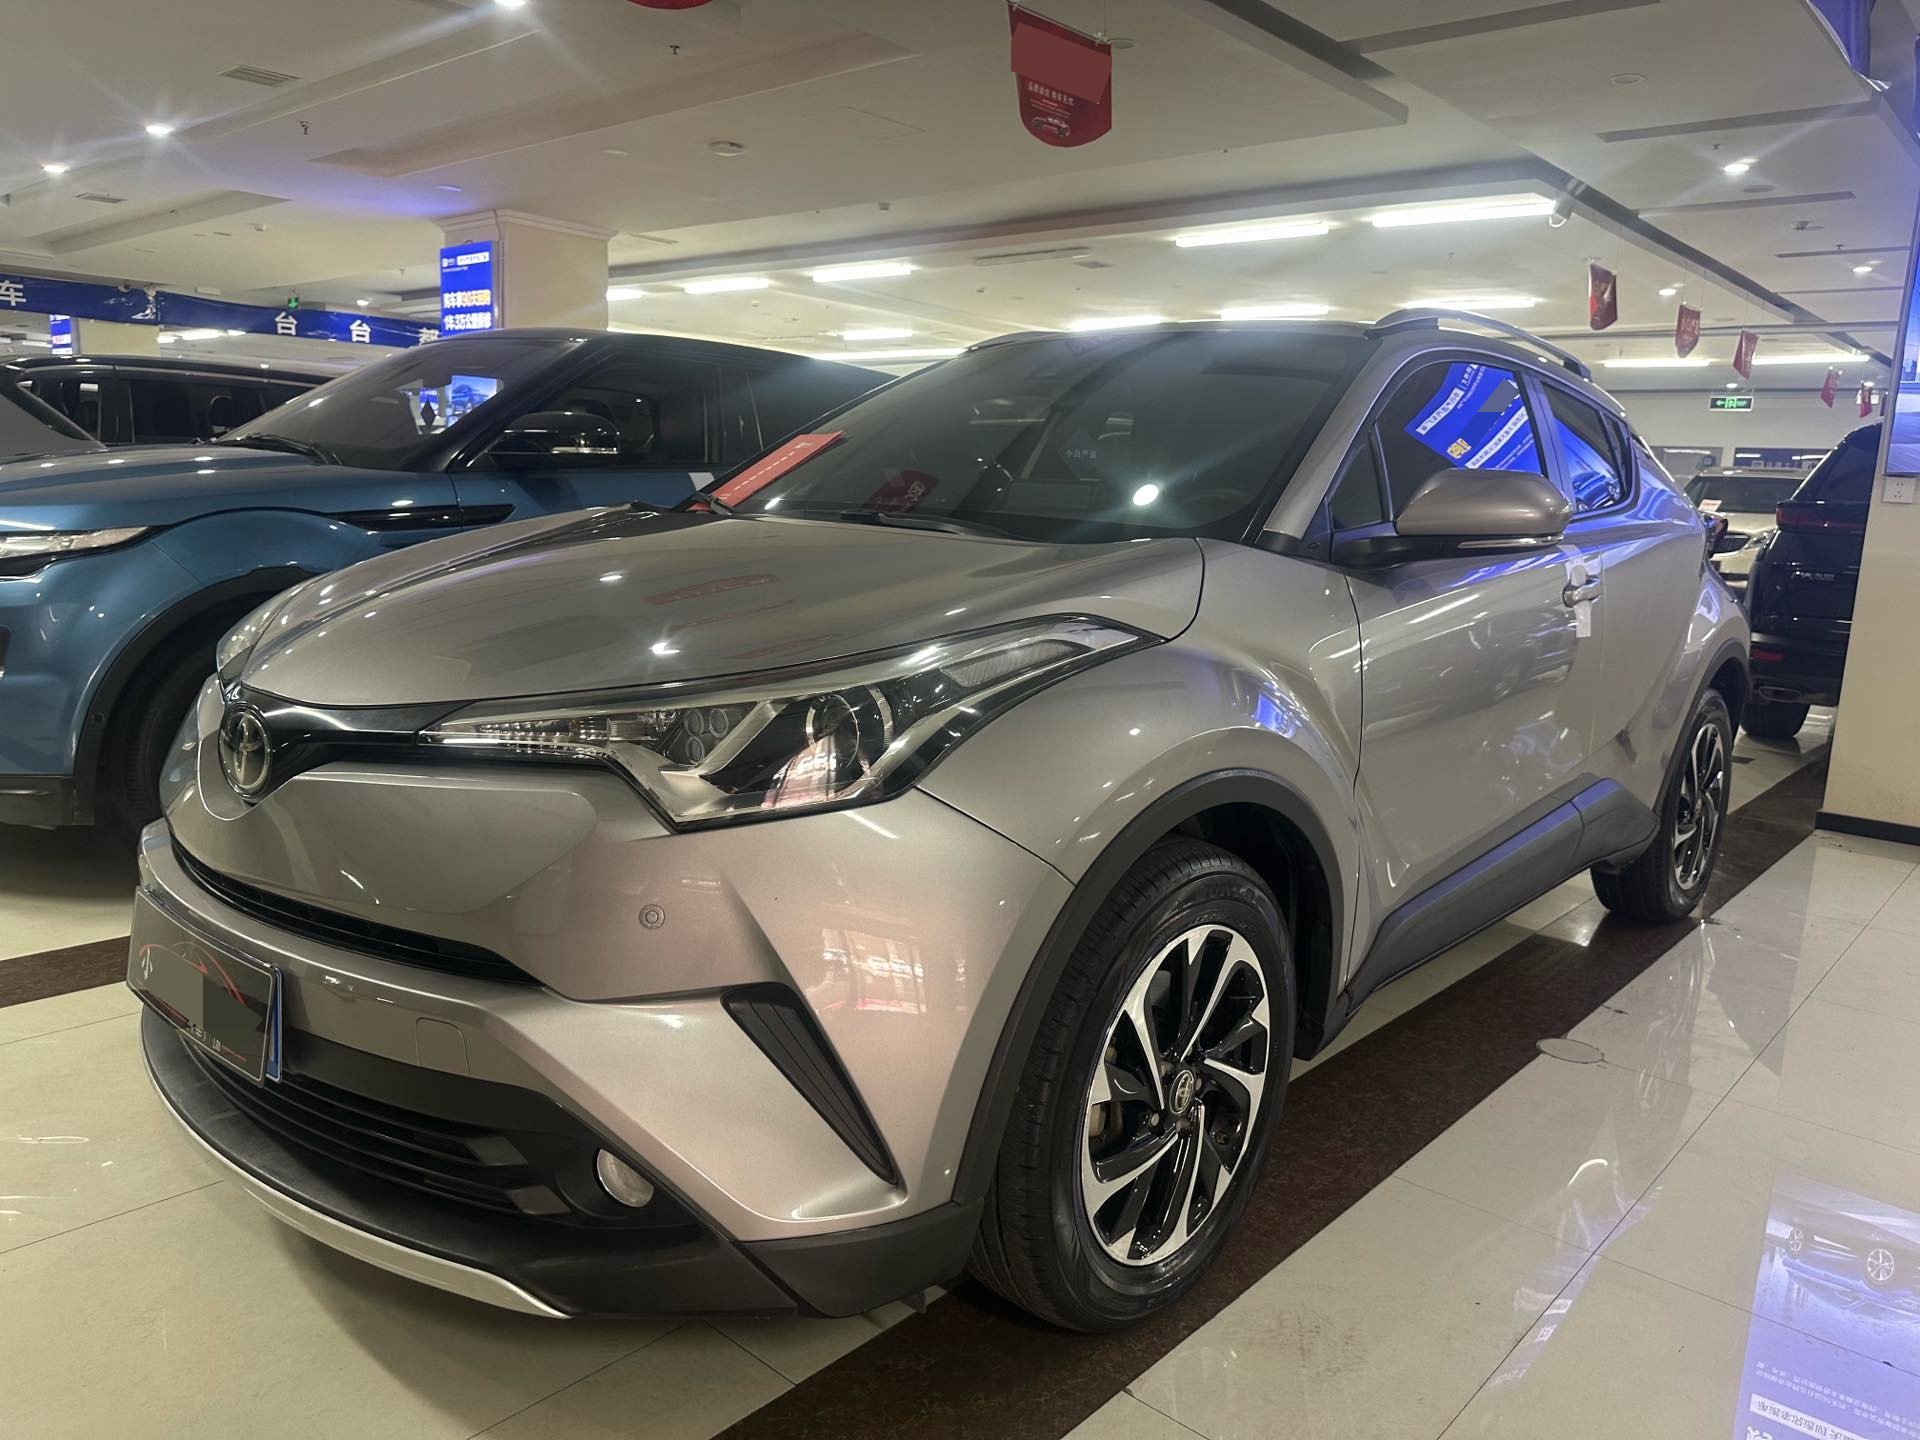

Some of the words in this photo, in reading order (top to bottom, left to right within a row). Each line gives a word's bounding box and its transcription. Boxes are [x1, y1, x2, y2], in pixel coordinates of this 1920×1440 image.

[0, 280, 27, 306] 车
[274, 311, 298, 336] 台
[349, 319, 372, 344] 台
